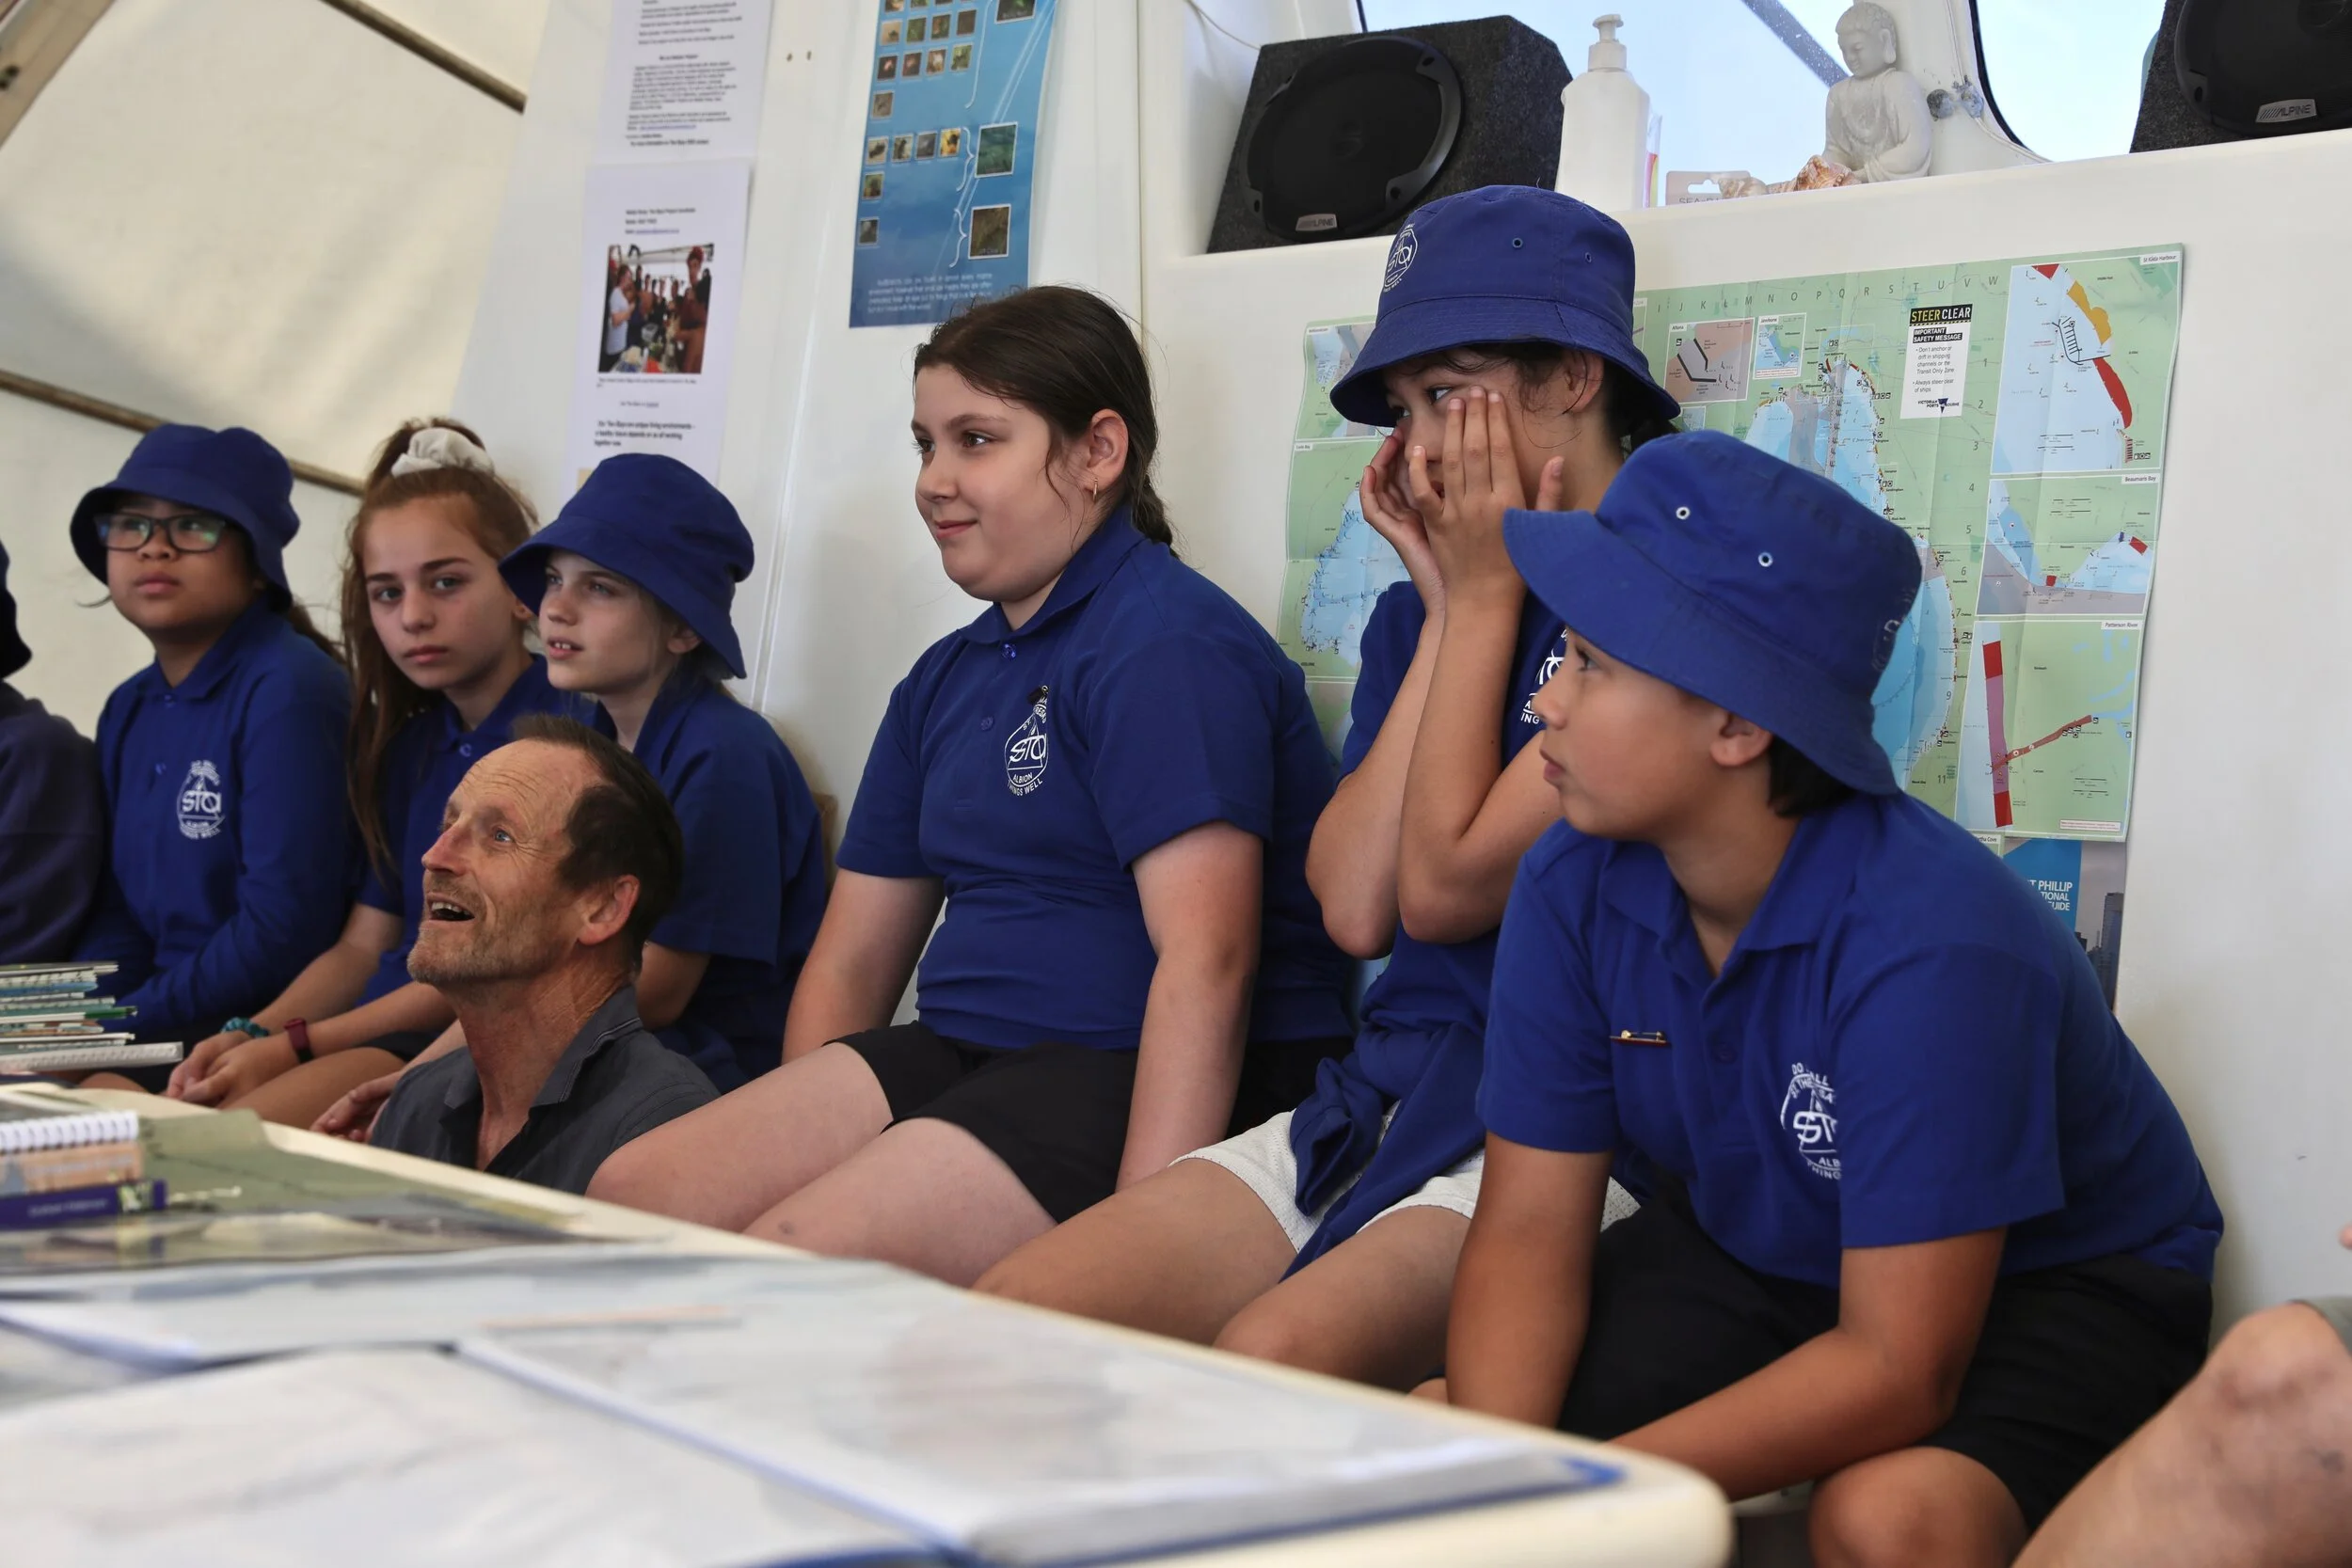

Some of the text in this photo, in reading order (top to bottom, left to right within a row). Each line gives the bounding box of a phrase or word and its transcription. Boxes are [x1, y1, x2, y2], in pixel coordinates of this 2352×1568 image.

[1745, 296, 1753, 305] M
[1768, 294, 1774, 303] N
[1791, 292, 1797, 301] O
[1838, 289, 1845, 298] Q
[1865, 287, 1869, 295] R
[1889, 285, 1894, 293] S
[1914, 283, 1919, 292] T
[1938, 280, 1944, 290] U
[1964, 278, 1971, 288] V
[1989, 277, 1998, 285] W
[1912, 307, 1971, 322] STEER CLEAR
[1978, 400, 1983, 409] 2
[1973, 441, 1979, 451] 3
[1968, 483, 1975, 492] 4
[1966, 525, 1972, 534] 5
[1961, 566, 1966, 576] 6
[1957, 608, 1962, 616] 7
[1946, 691, 1951, 700] 9
[1013, 772, 1033, 784] ALBION
[1938, 775, 1946, 784] 11
[1025, 778, 1043, 795] WELL
[2038, 880, 2073, 892] PHILLIP
[1791, 1062, 1804, 1075] DO
